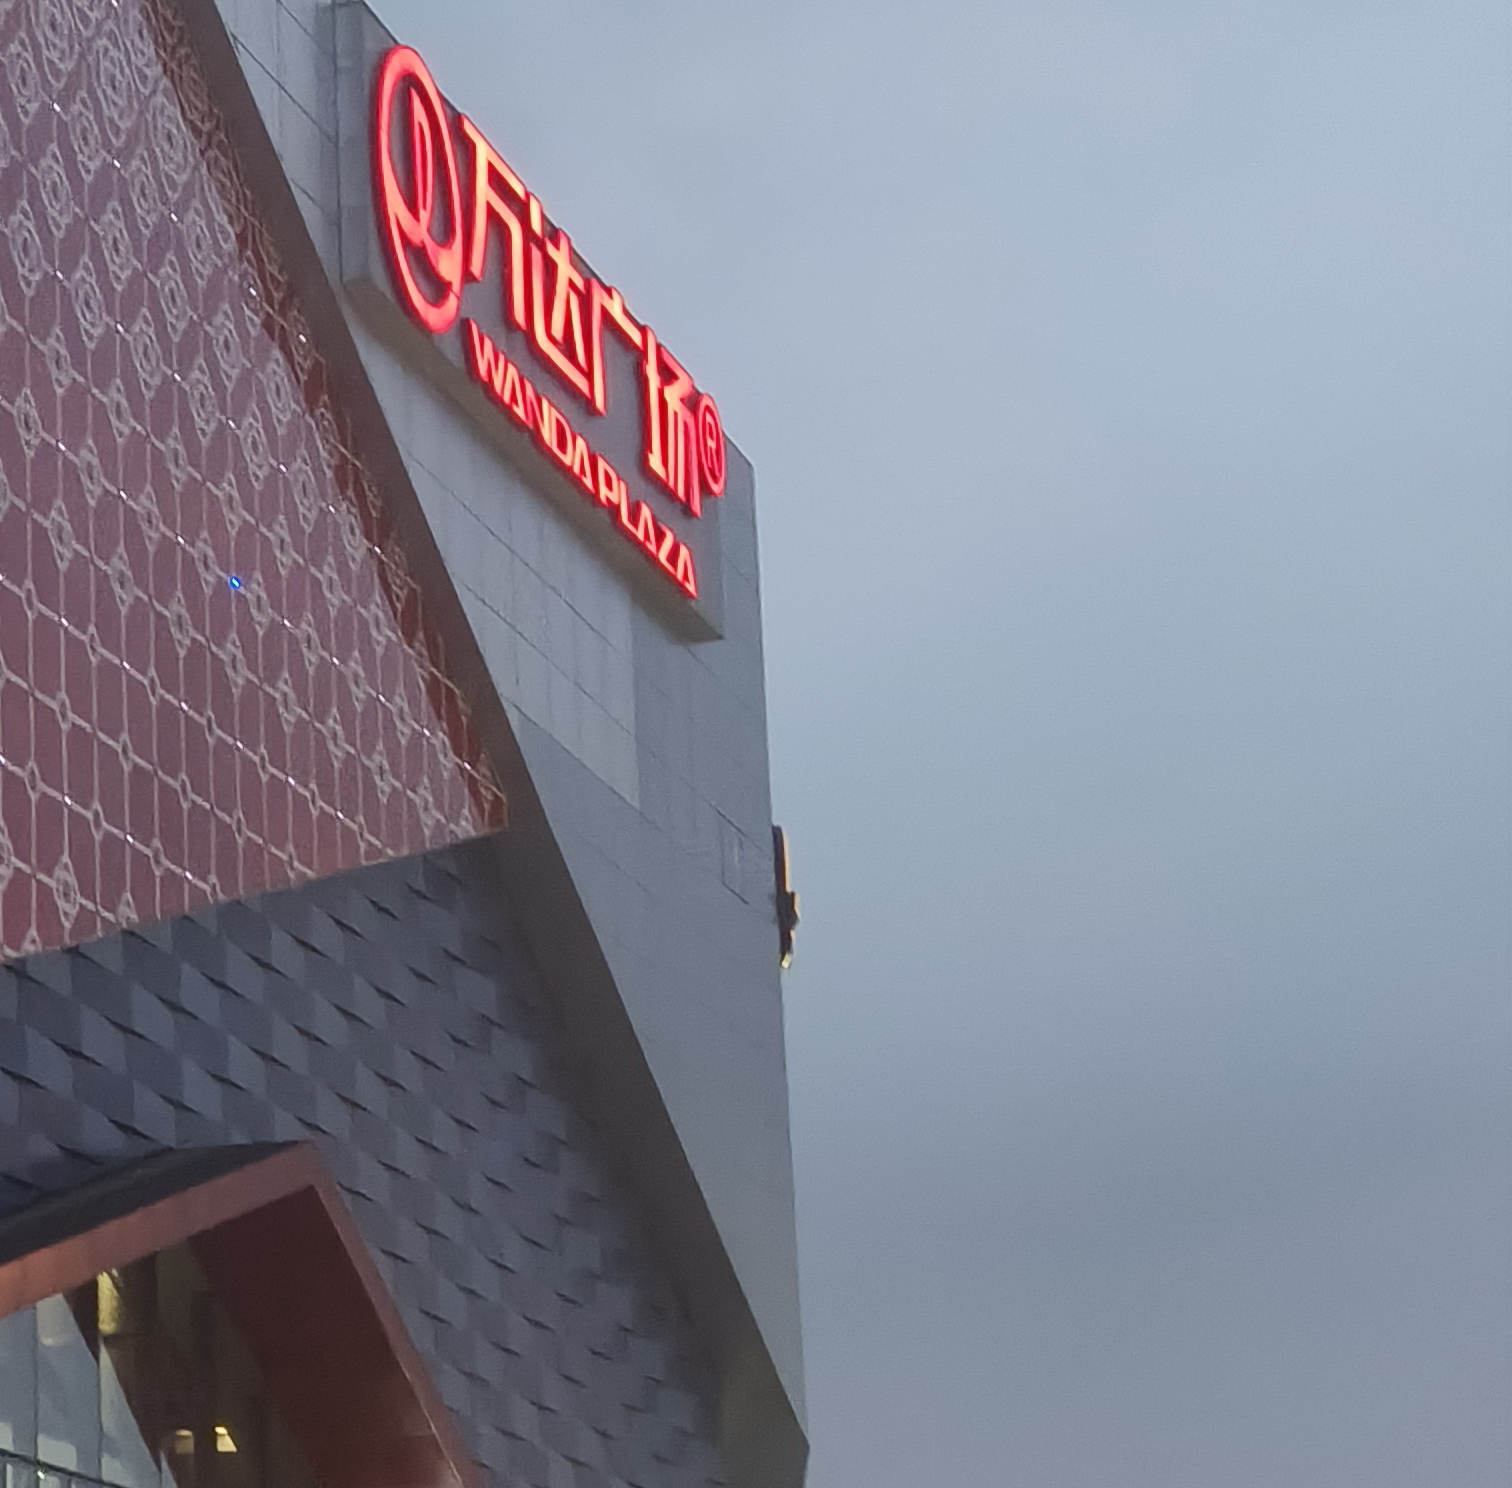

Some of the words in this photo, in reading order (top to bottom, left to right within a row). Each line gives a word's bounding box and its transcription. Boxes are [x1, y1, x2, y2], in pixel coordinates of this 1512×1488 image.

[460, 114, 702, 519] 万达广场
[465, 317, 596, 495] WANDA
[595, 453, 698, 599] PLAZA
